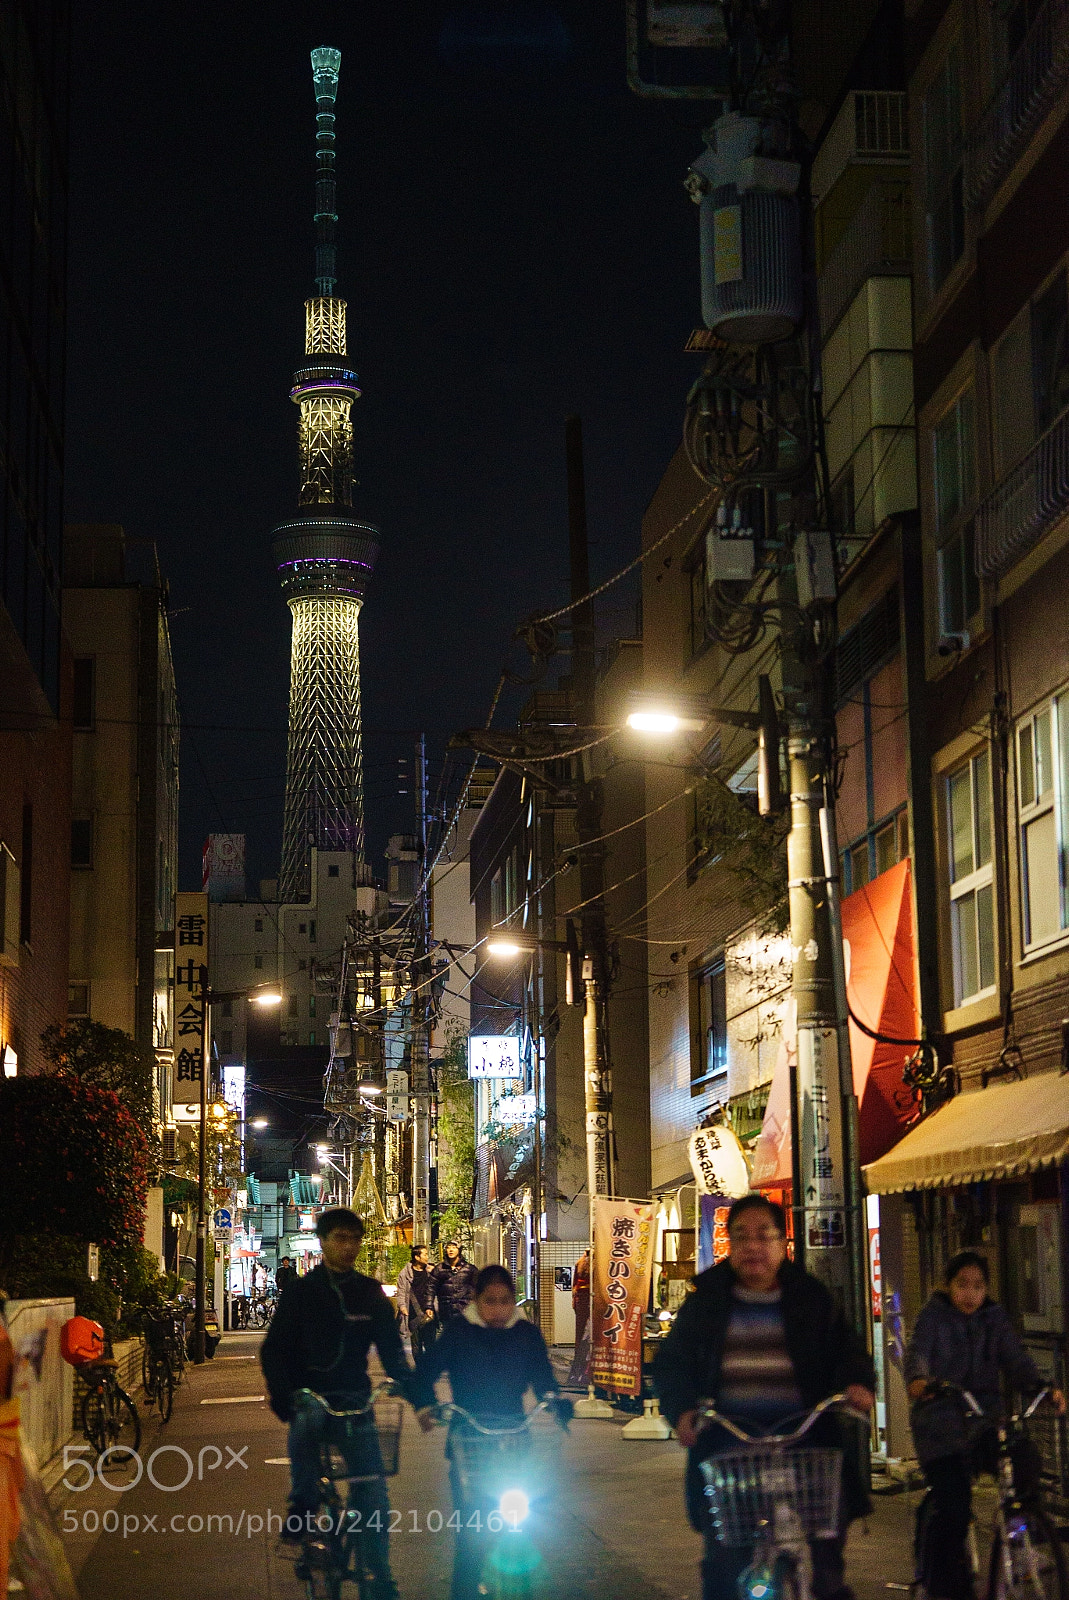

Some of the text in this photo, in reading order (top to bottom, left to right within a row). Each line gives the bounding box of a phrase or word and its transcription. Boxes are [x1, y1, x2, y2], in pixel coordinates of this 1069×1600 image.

[176, 914, 206, 1082] 雷中会館
[603, 1217, 635, 1344] 焼きいもパイ
